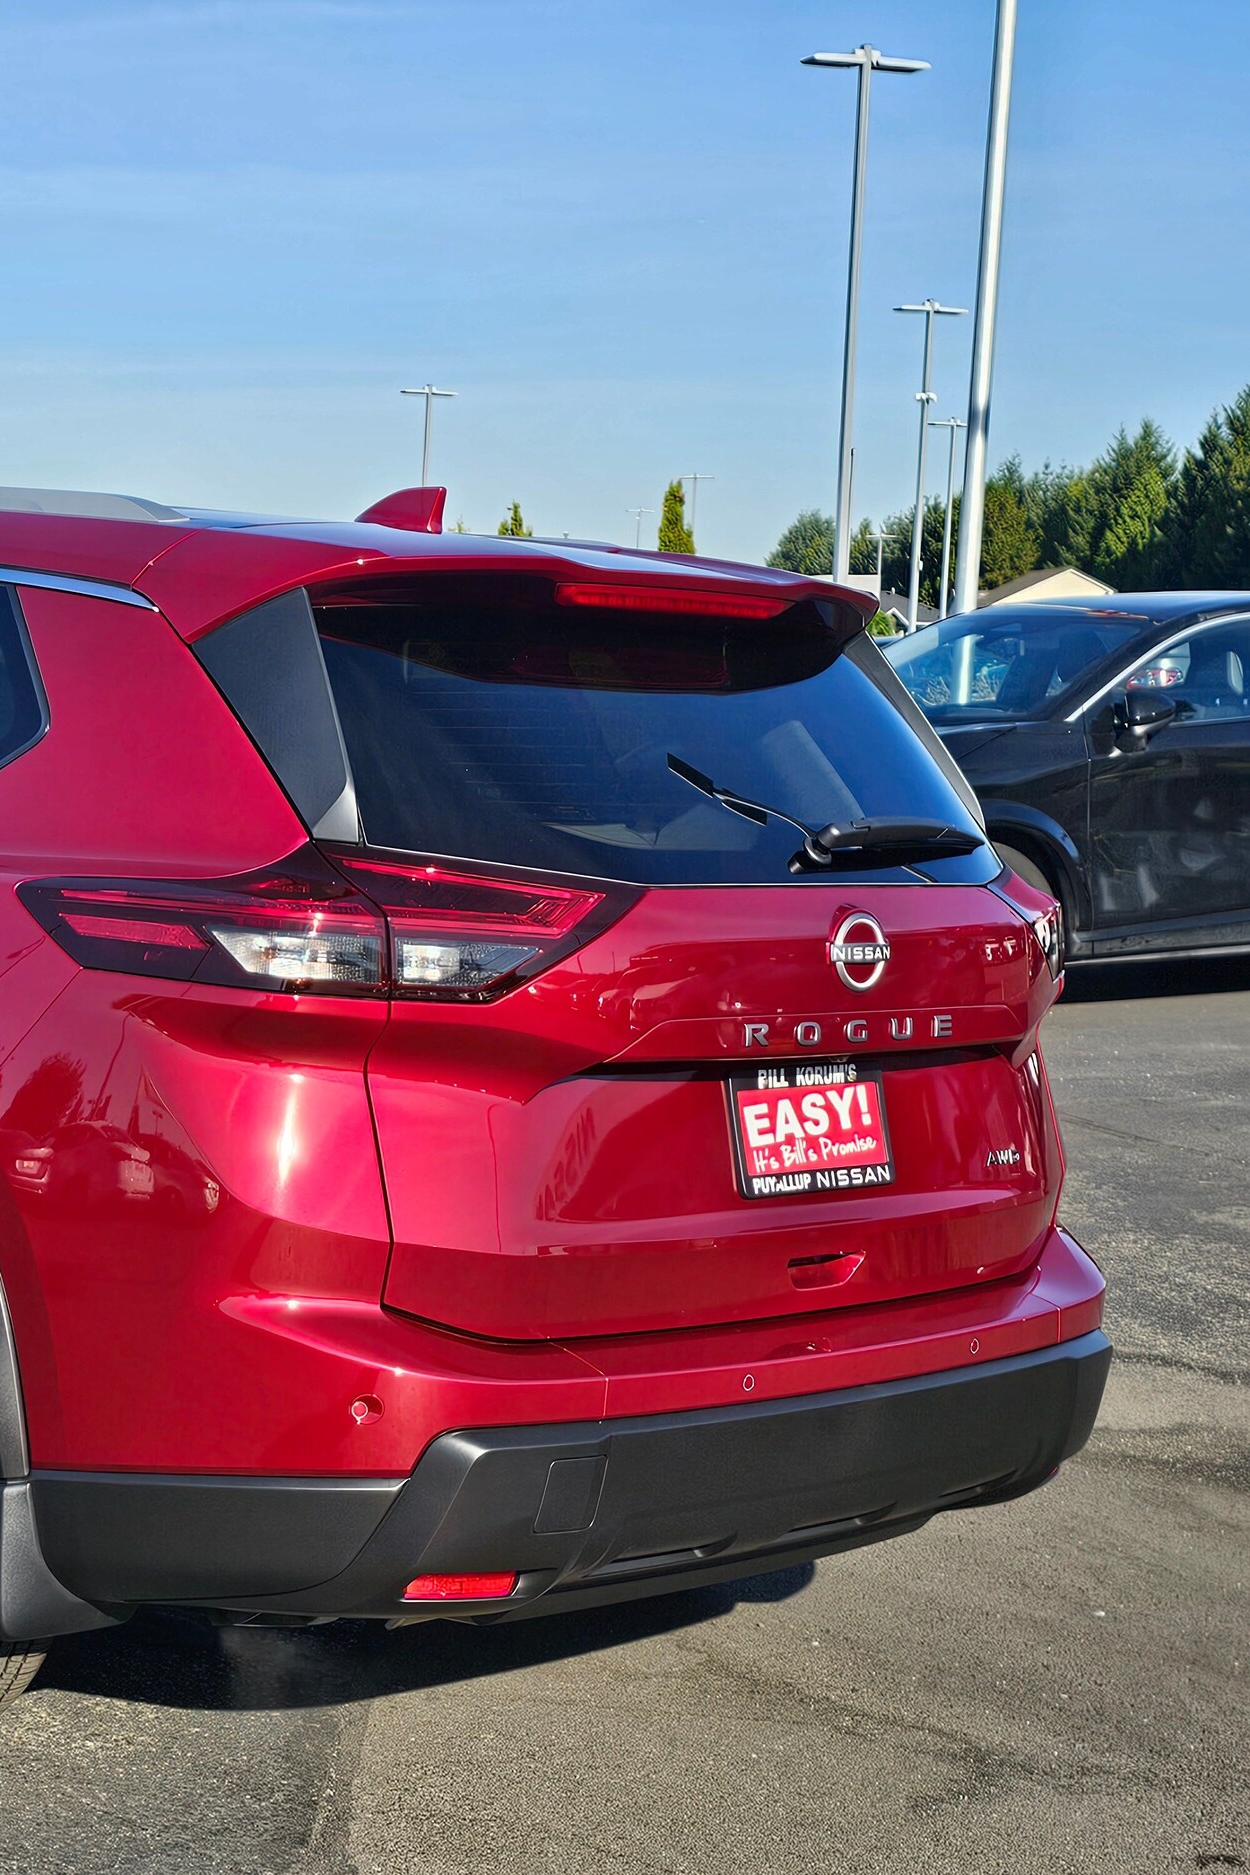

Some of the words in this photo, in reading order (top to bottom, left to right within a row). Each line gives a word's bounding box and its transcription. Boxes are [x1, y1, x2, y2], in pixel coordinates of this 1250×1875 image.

[832, 945, 891, 961] NISSAN
[743, 1014, 954, 1047] ROGUE
[743, 1084, 872, 1148] EASY!
[753, 1148, 780, 1173] It's
[780, 1139, 818, 1167] Bill's
[818, 1134, 877, 1160] Promise
[816, 1165, 891, 1188] NISSAN
